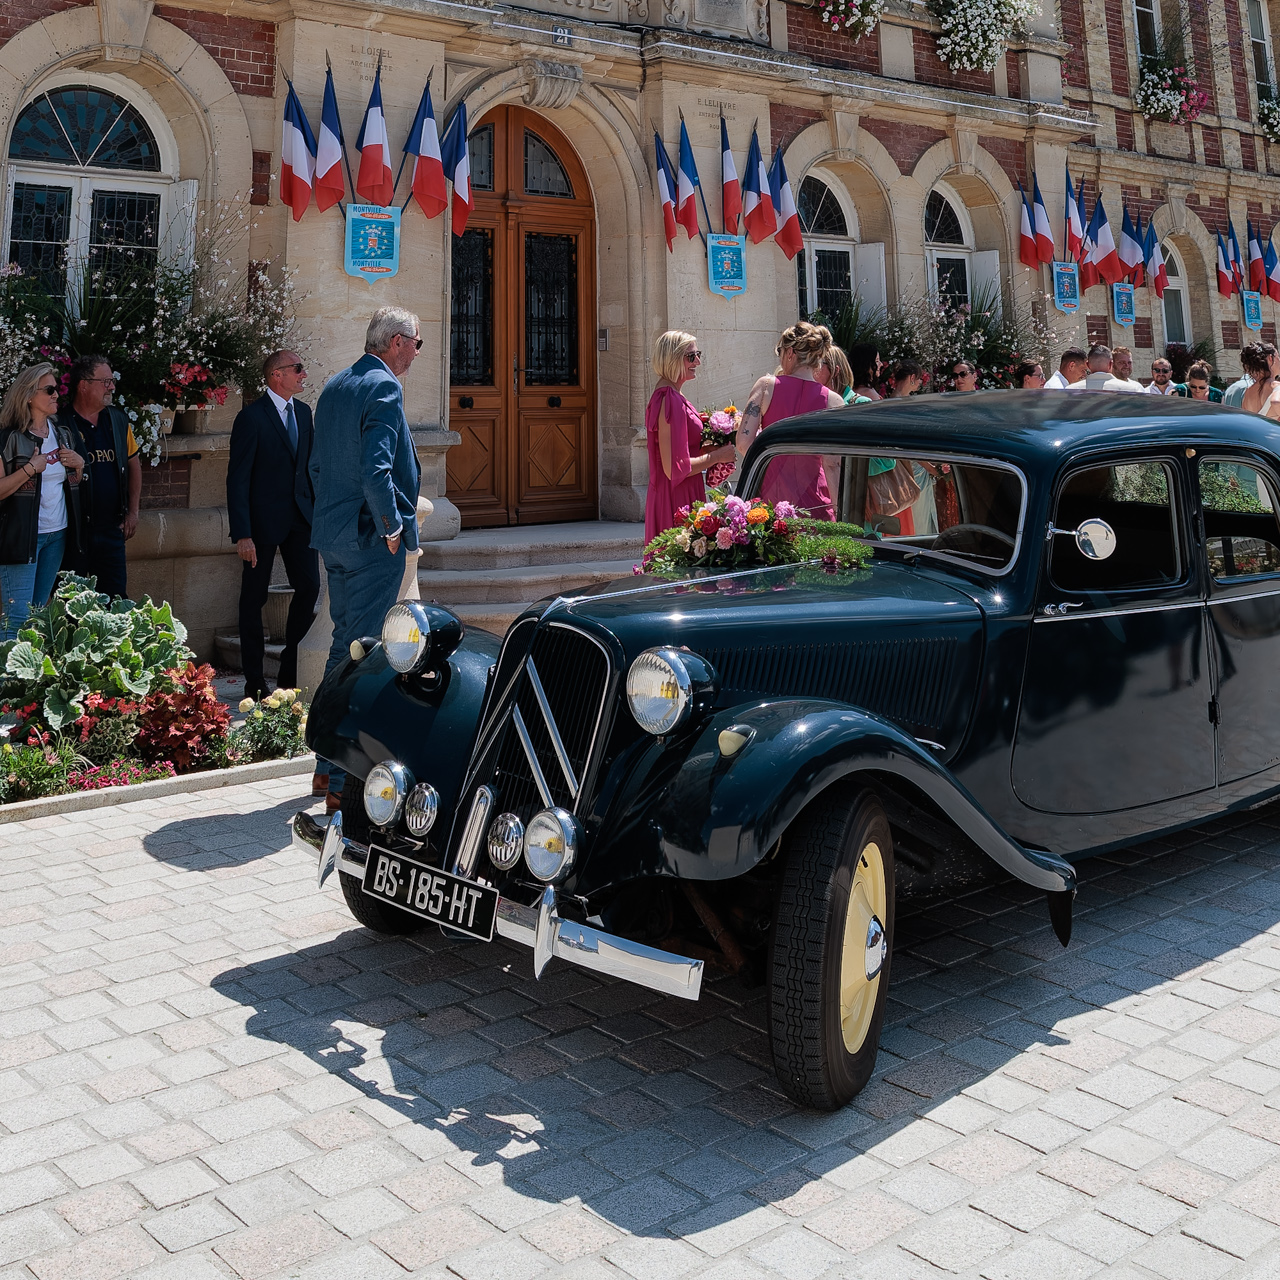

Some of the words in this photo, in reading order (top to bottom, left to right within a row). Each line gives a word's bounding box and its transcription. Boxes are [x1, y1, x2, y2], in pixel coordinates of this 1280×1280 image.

[556, 27, 568, 44] 21
[361, 46, 392, 58] LOISEL
[351, 60, 393, 72] ARCHITTE
